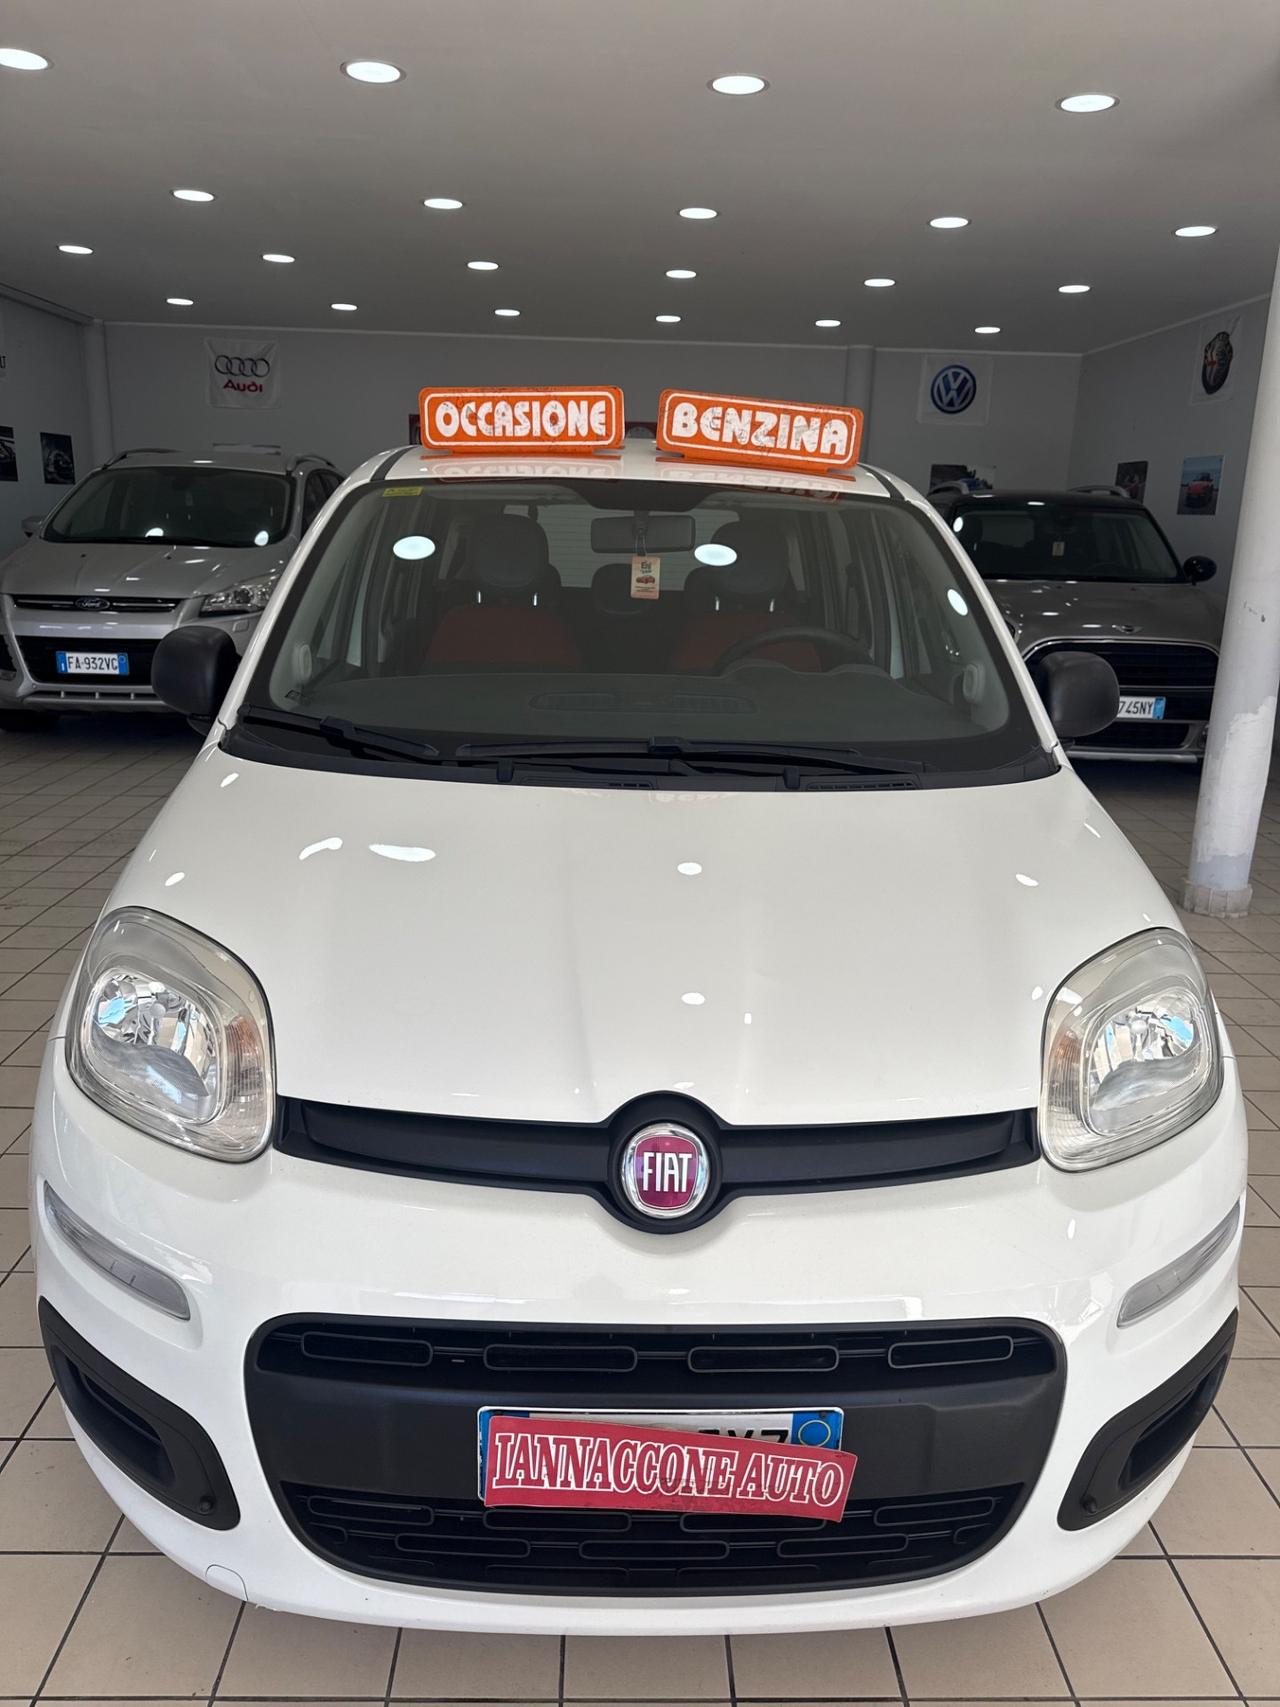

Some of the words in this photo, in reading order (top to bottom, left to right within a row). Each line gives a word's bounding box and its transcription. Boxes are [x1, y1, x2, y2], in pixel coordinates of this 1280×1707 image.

[223, 380, 263, 393] Audi
[435, 400, 606, 437] OCCASIONE
[671, 402, 849, 455] BENZINA
[642, 1151, 693, 1193] FIAT
[492, 1433, 739, 1497] IANNACCONE
[736, 1452, 845, 1508] AUTO
